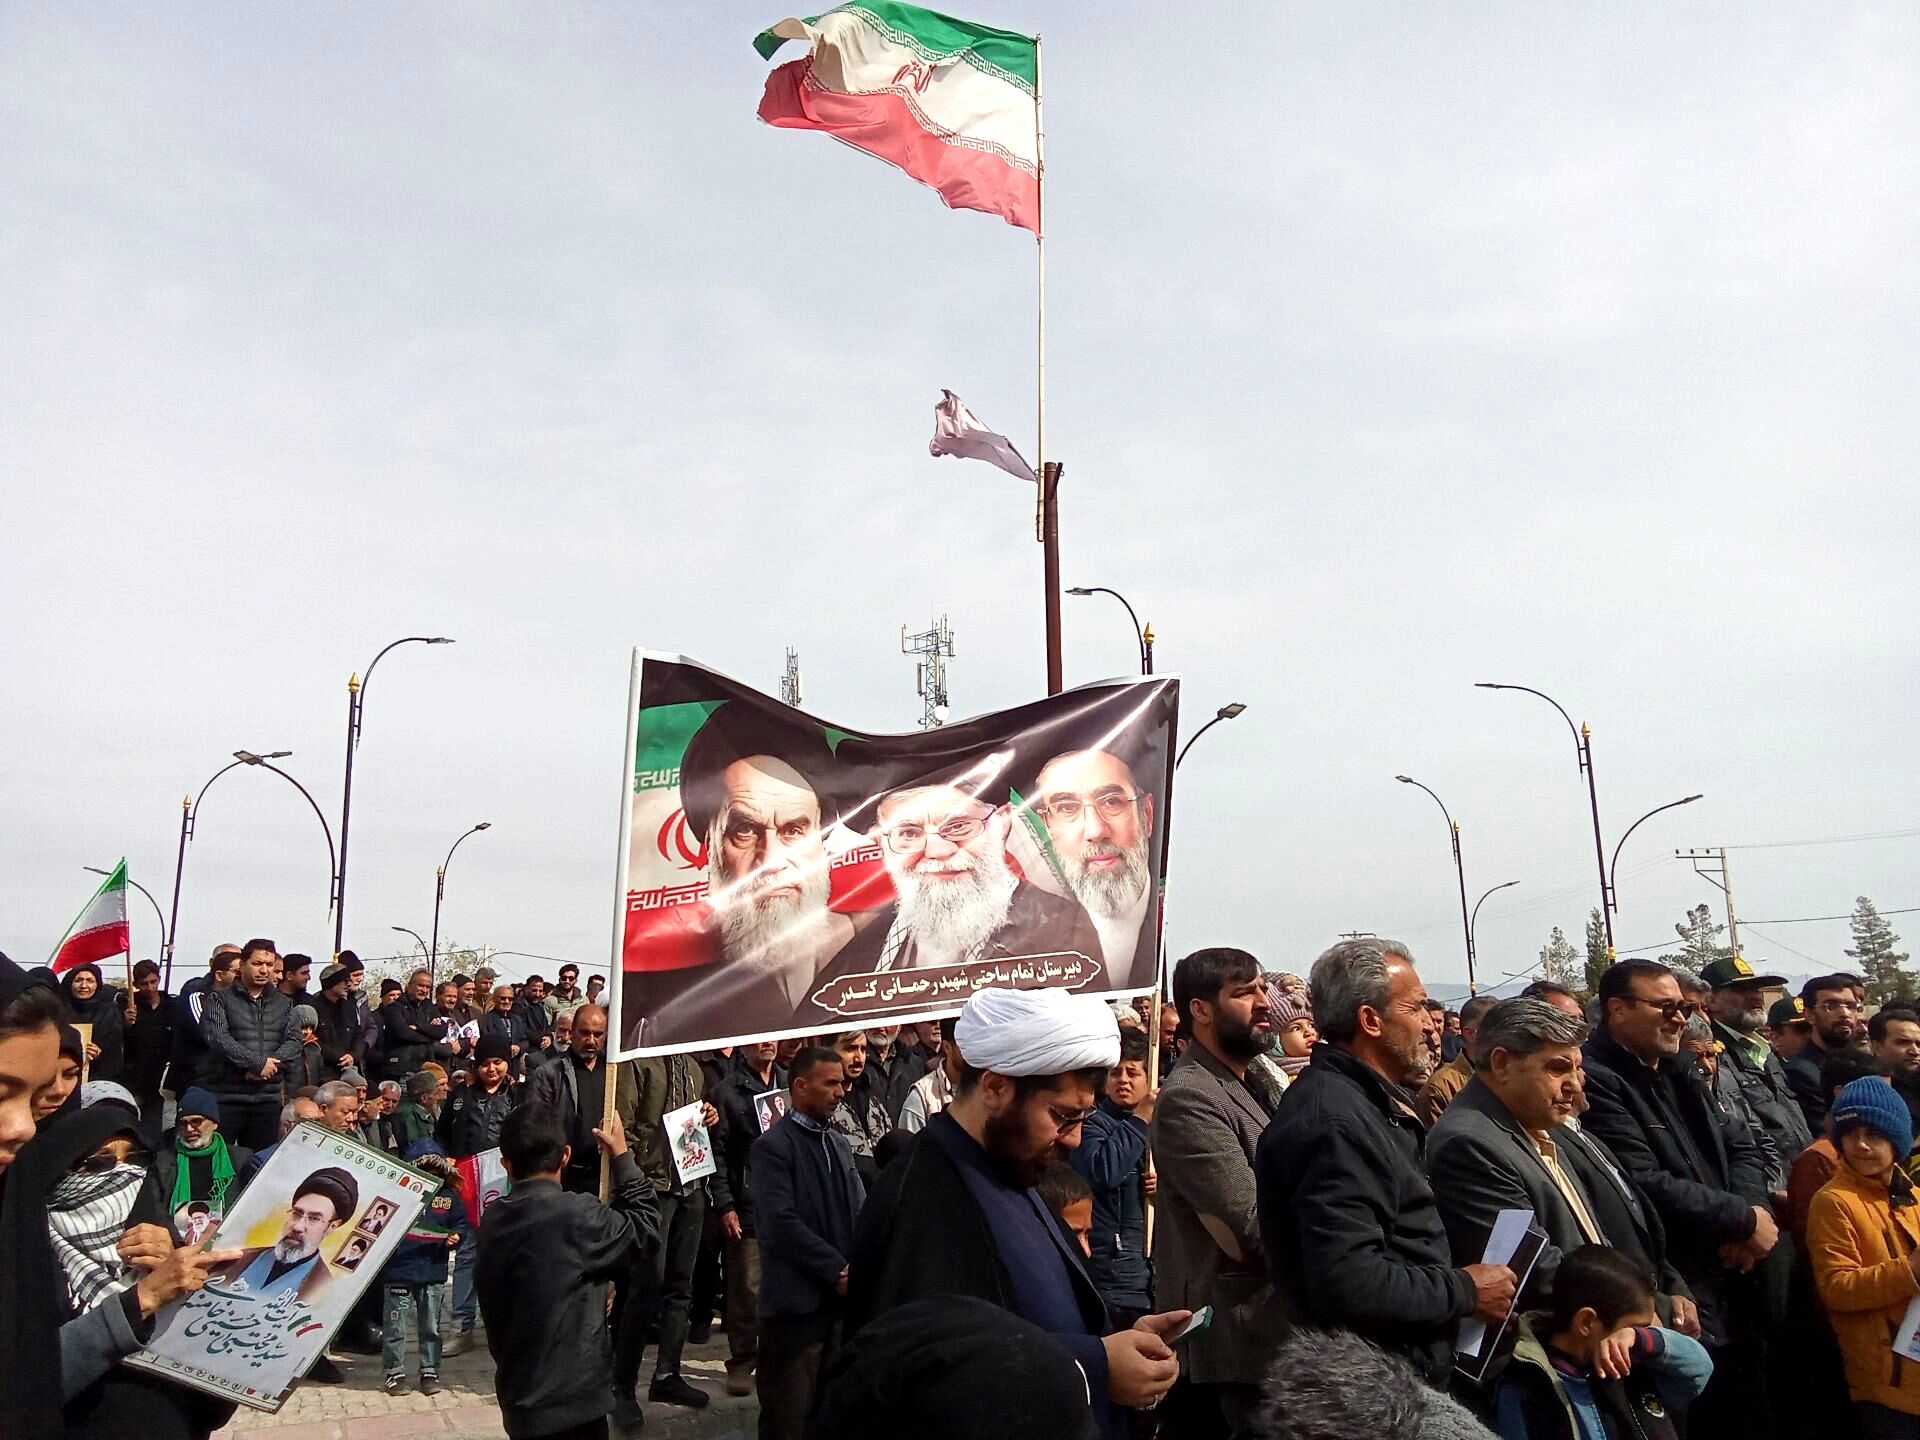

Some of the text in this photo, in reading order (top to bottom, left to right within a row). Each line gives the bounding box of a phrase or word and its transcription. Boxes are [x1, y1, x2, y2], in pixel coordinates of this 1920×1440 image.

[838, 959, 1082, 1006] دبیرستان تمام ساحتی شهید رحمانی کندر
